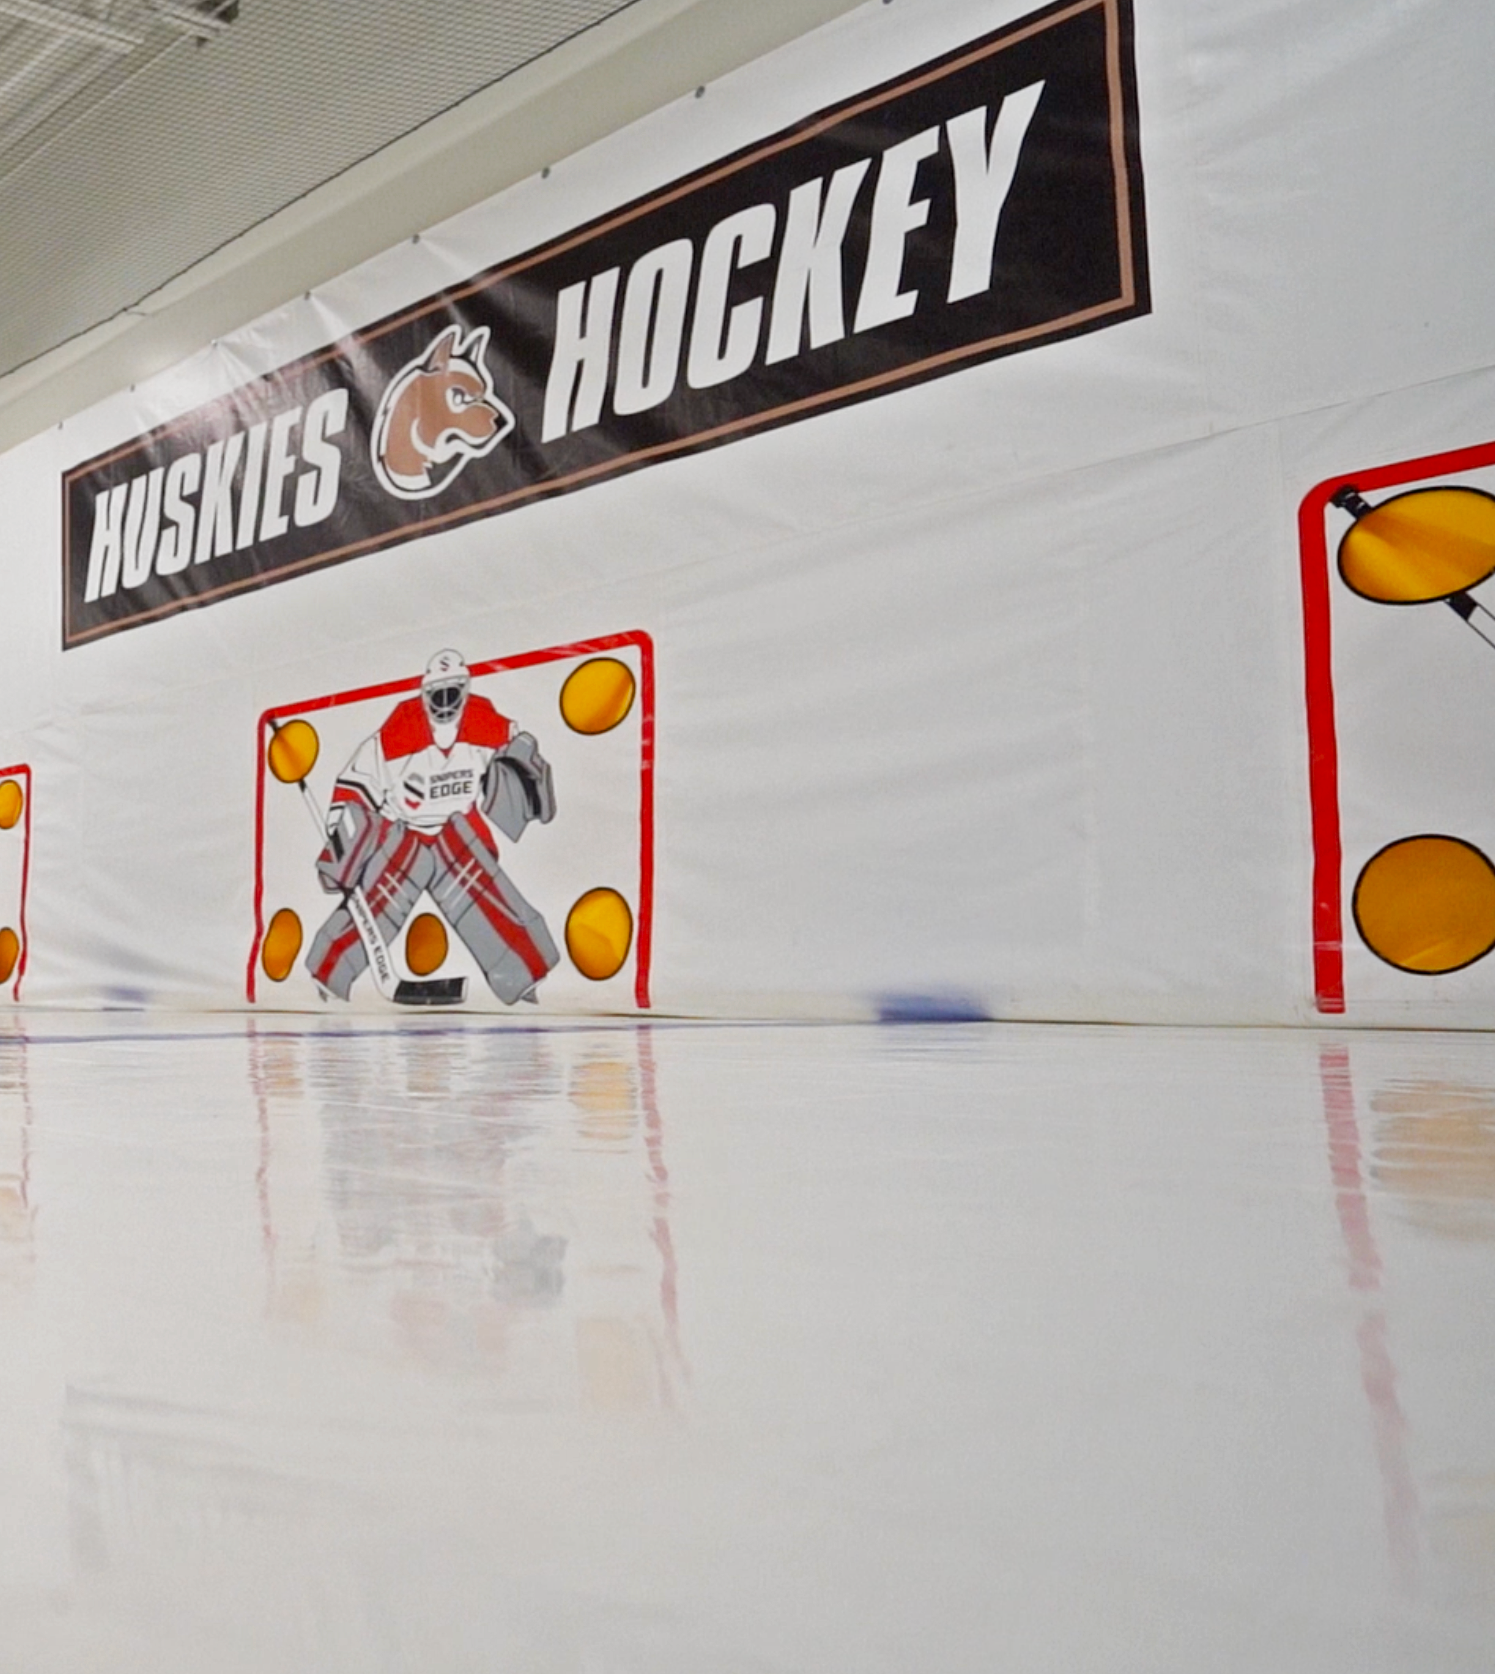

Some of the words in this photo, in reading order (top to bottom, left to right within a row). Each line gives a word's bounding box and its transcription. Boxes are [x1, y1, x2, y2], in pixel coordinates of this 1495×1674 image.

[84, 388, 349, 603] HUSKIES
[542, 80, 1045, 443] HOCKEY
[429, 768, 474, 784] SNIPERS
[429, 781, 474, 799] EDGE
[373, 945, 391, 984] EDGE
